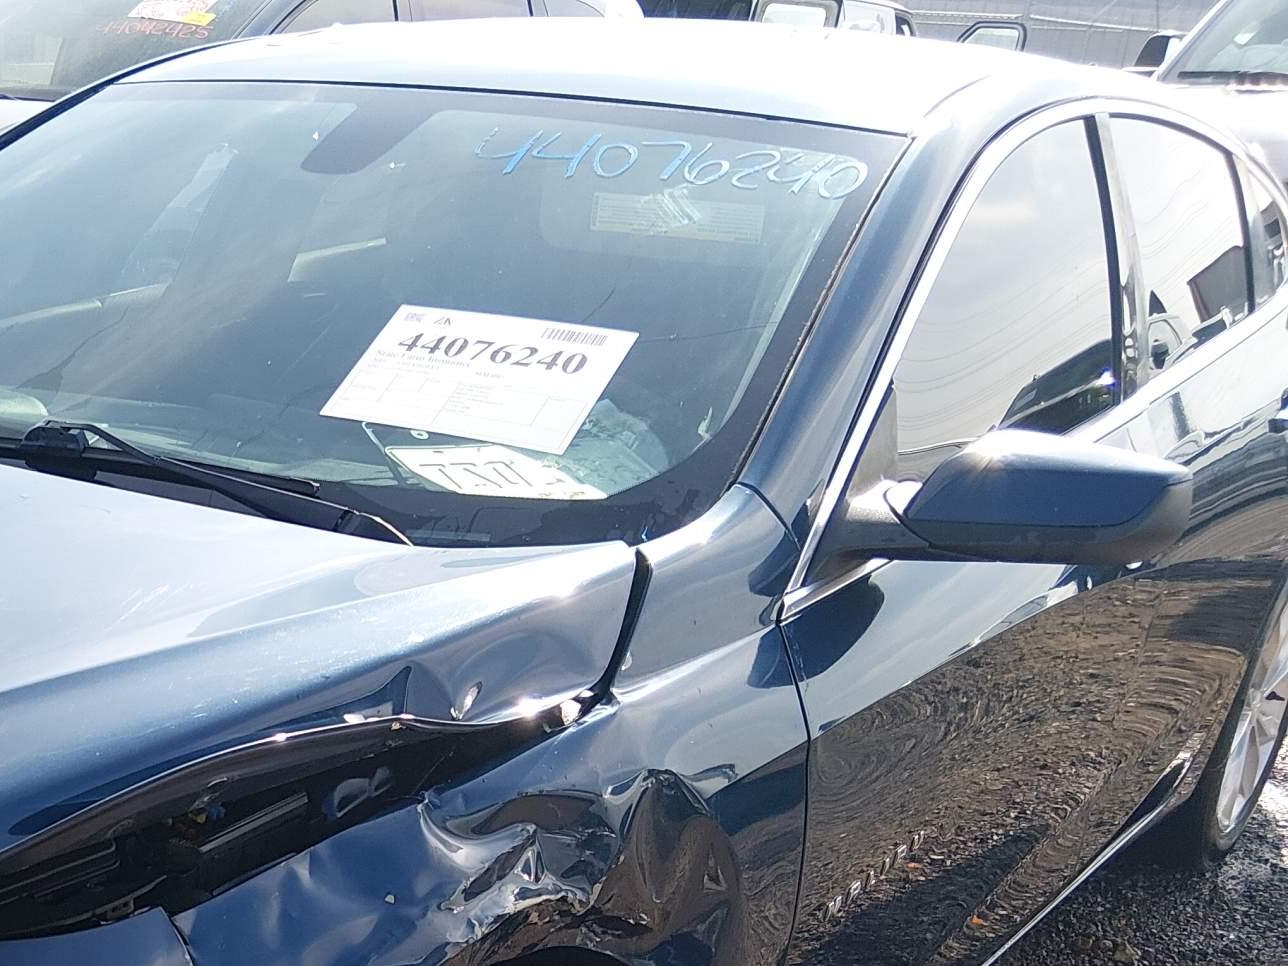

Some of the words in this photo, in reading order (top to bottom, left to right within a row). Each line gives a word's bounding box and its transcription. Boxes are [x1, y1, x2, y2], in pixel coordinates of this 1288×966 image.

[474, 127, 869, 199] 44076240
[398, 332, 588, 375] 44076240
[822, 830, 925, 922] MALIBU
